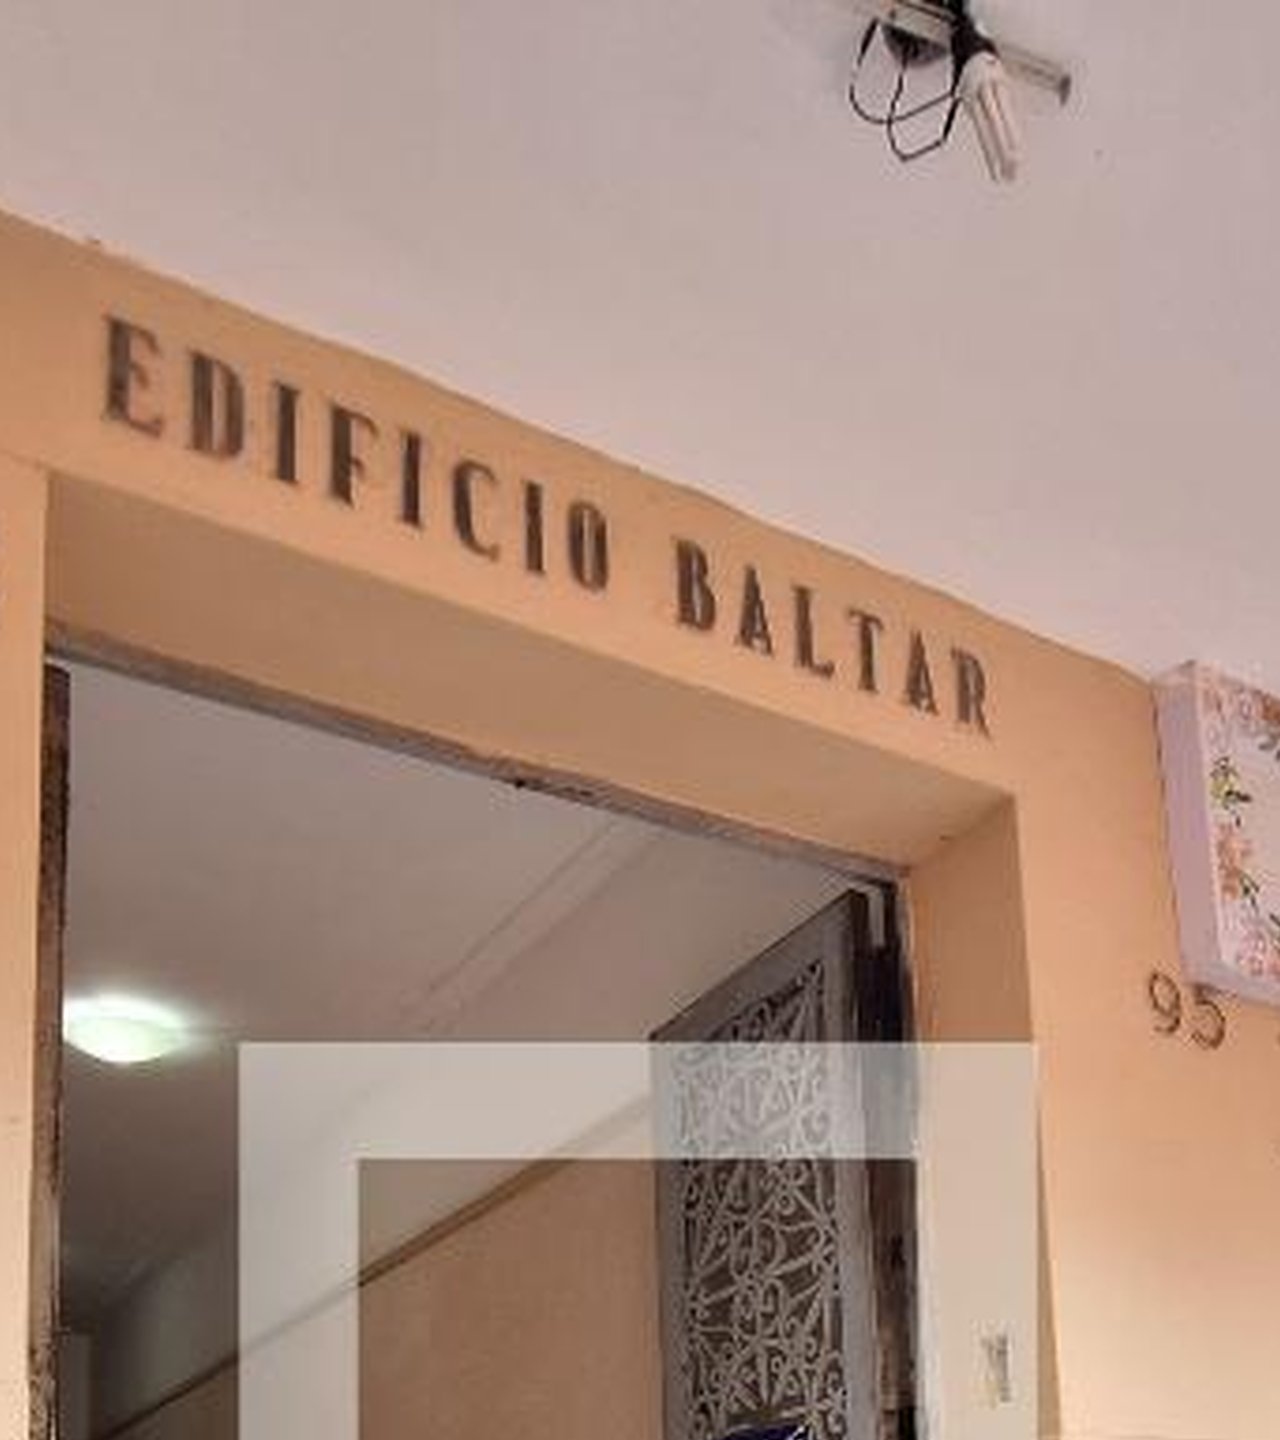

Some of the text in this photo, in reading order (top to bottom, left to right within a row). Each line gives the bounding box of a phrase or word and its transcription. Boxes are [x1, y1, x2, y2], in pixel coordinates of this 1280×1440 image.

[101, 312, 992, 739] EDIFICIO BALTAR
[1147, 971, 1229, 1051] 95
